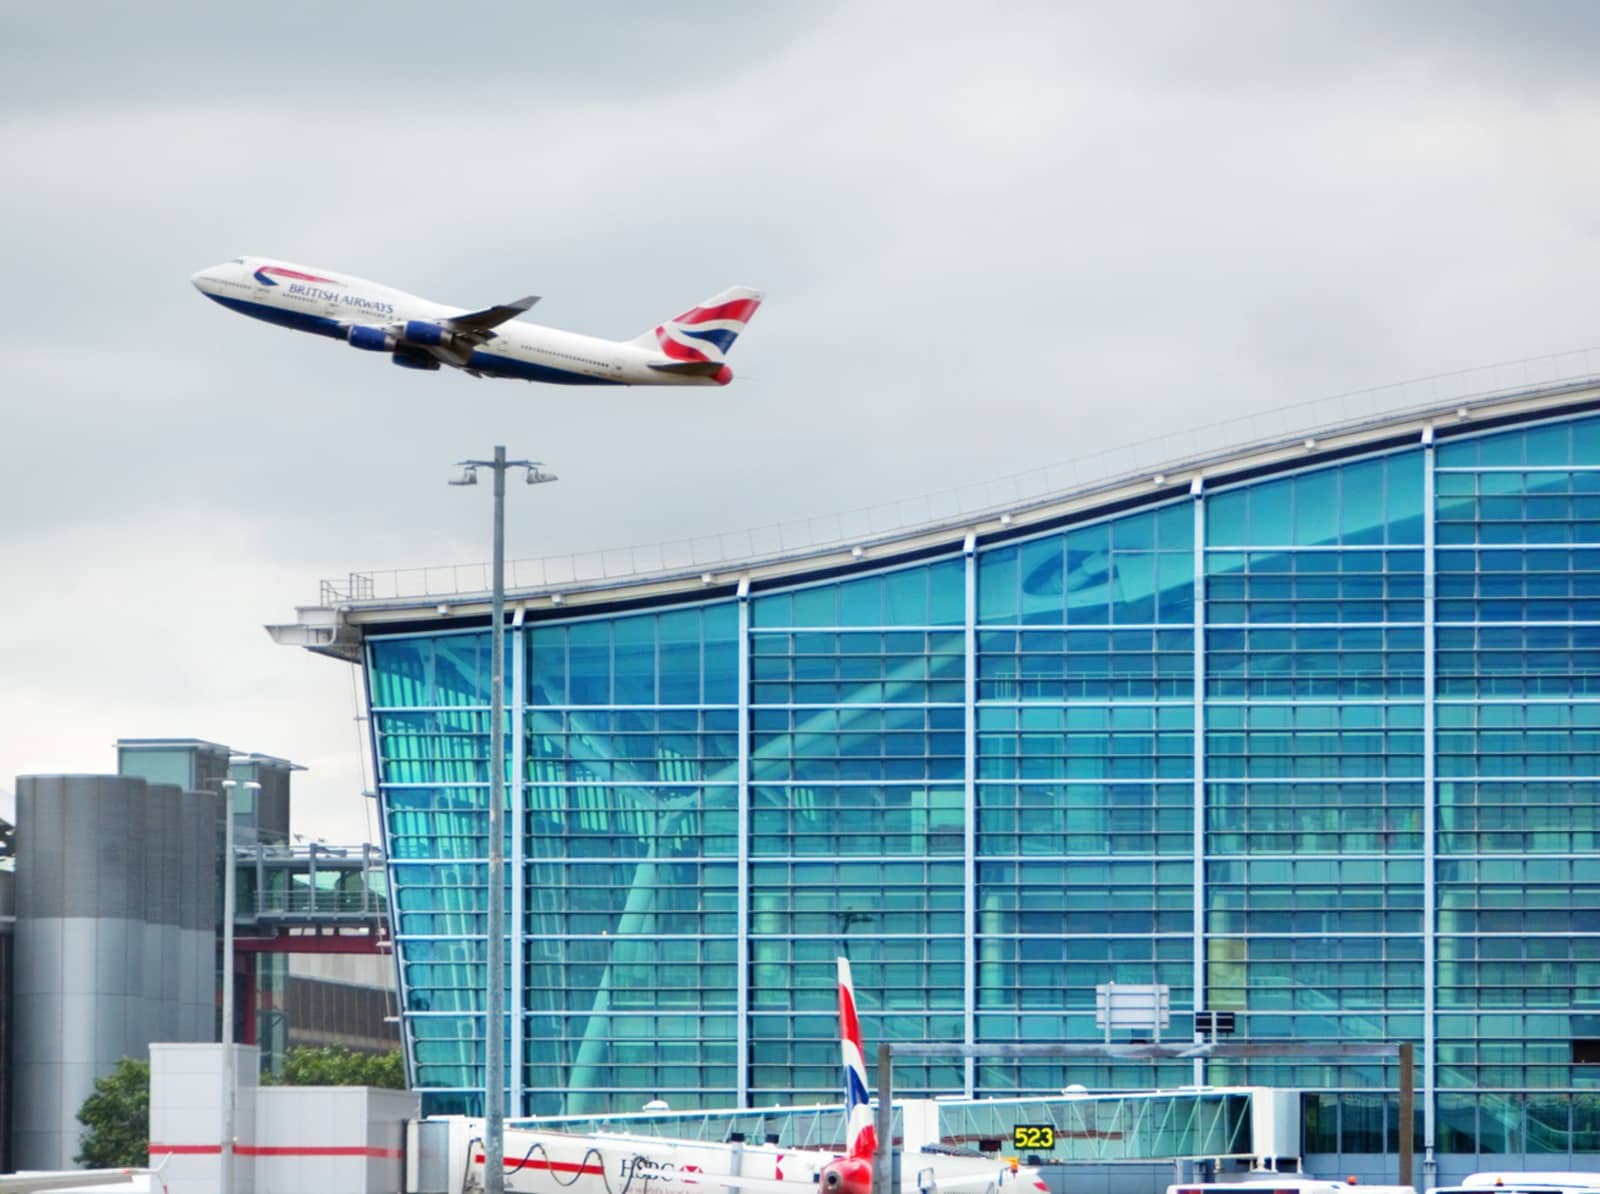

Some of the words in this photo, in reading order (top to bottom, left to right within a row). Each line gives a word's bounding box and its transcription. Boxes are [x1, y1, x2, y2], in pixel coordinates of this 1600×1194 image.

[289, 283, 340, 302] BRITISH
[341, 295, 393, 314] AIRWAYS
[1015, 1127, 1053, 1147] 523
